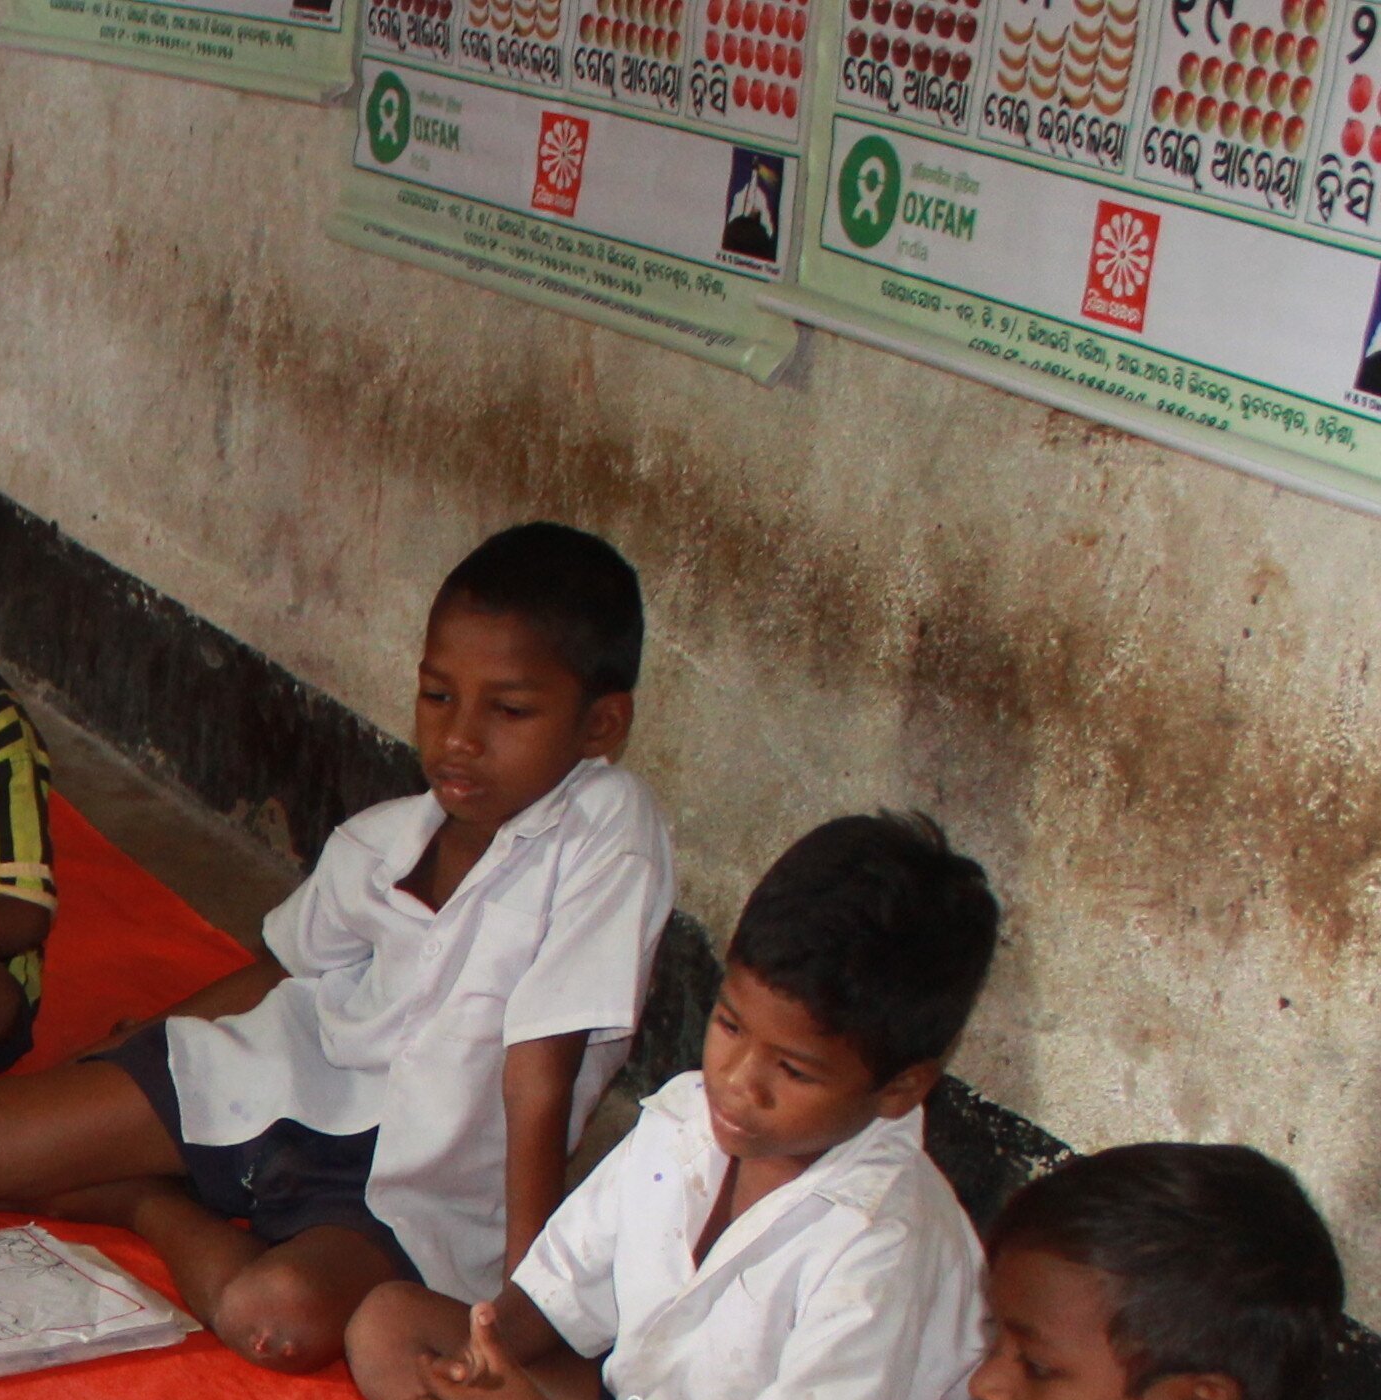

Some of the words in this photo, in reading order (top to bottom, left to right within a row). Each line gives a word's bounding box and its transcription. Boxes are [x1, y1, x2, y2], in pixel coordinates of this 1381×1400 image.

[414, 114, 460, 153] OXFAM
[903, 191, 978, 241] OXFAM
[897, 234, 928, 262] India
